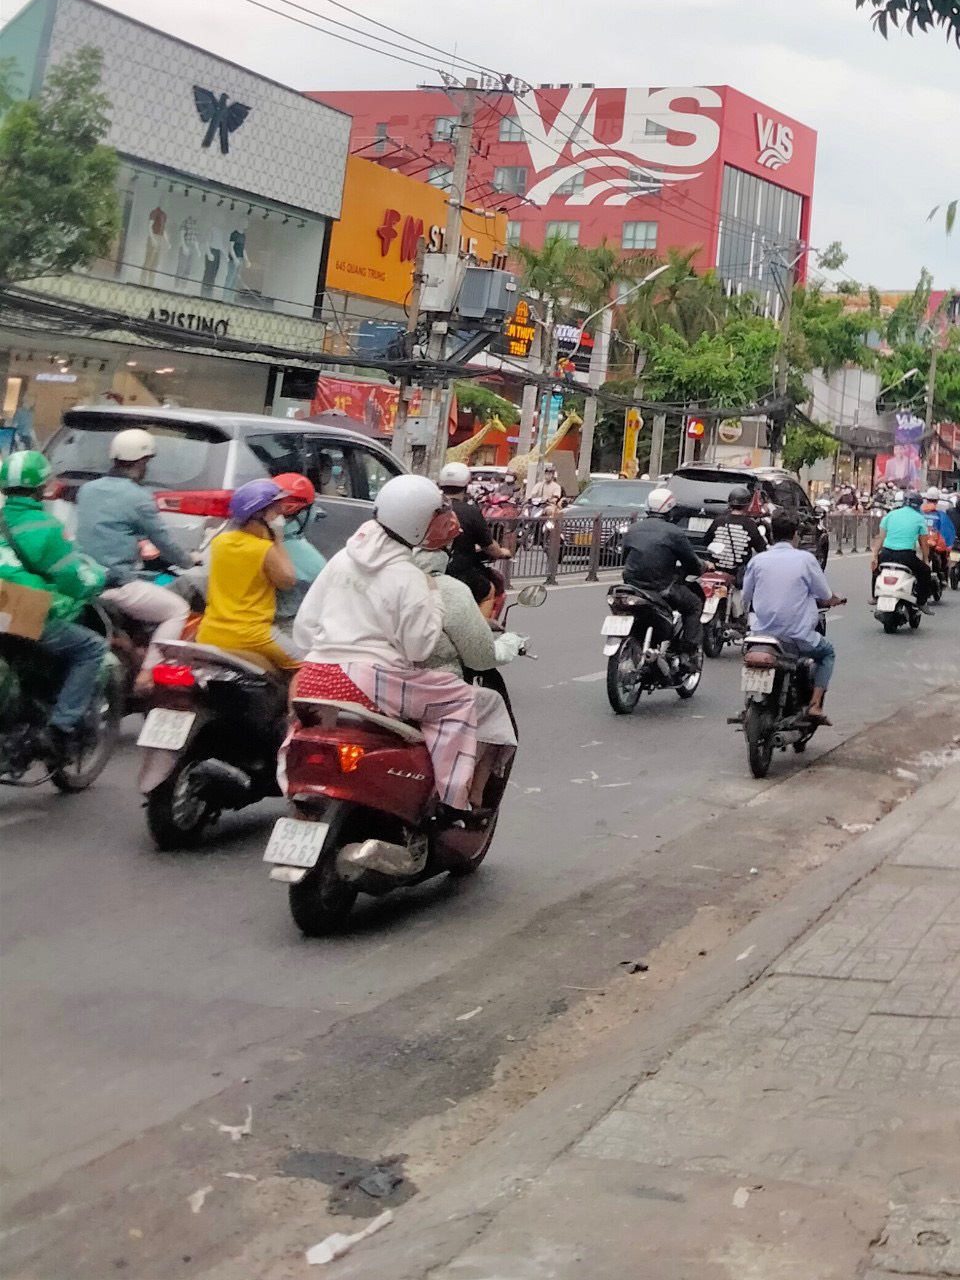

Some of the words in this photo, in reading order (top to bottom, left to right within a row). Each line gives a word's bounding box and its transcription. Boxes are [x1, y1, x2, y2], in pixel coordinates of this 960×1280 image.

[513, 87, 723, 174] VUS
[753, 112, 794, 162] VUS
[427, 224, 479, 255] STLE
